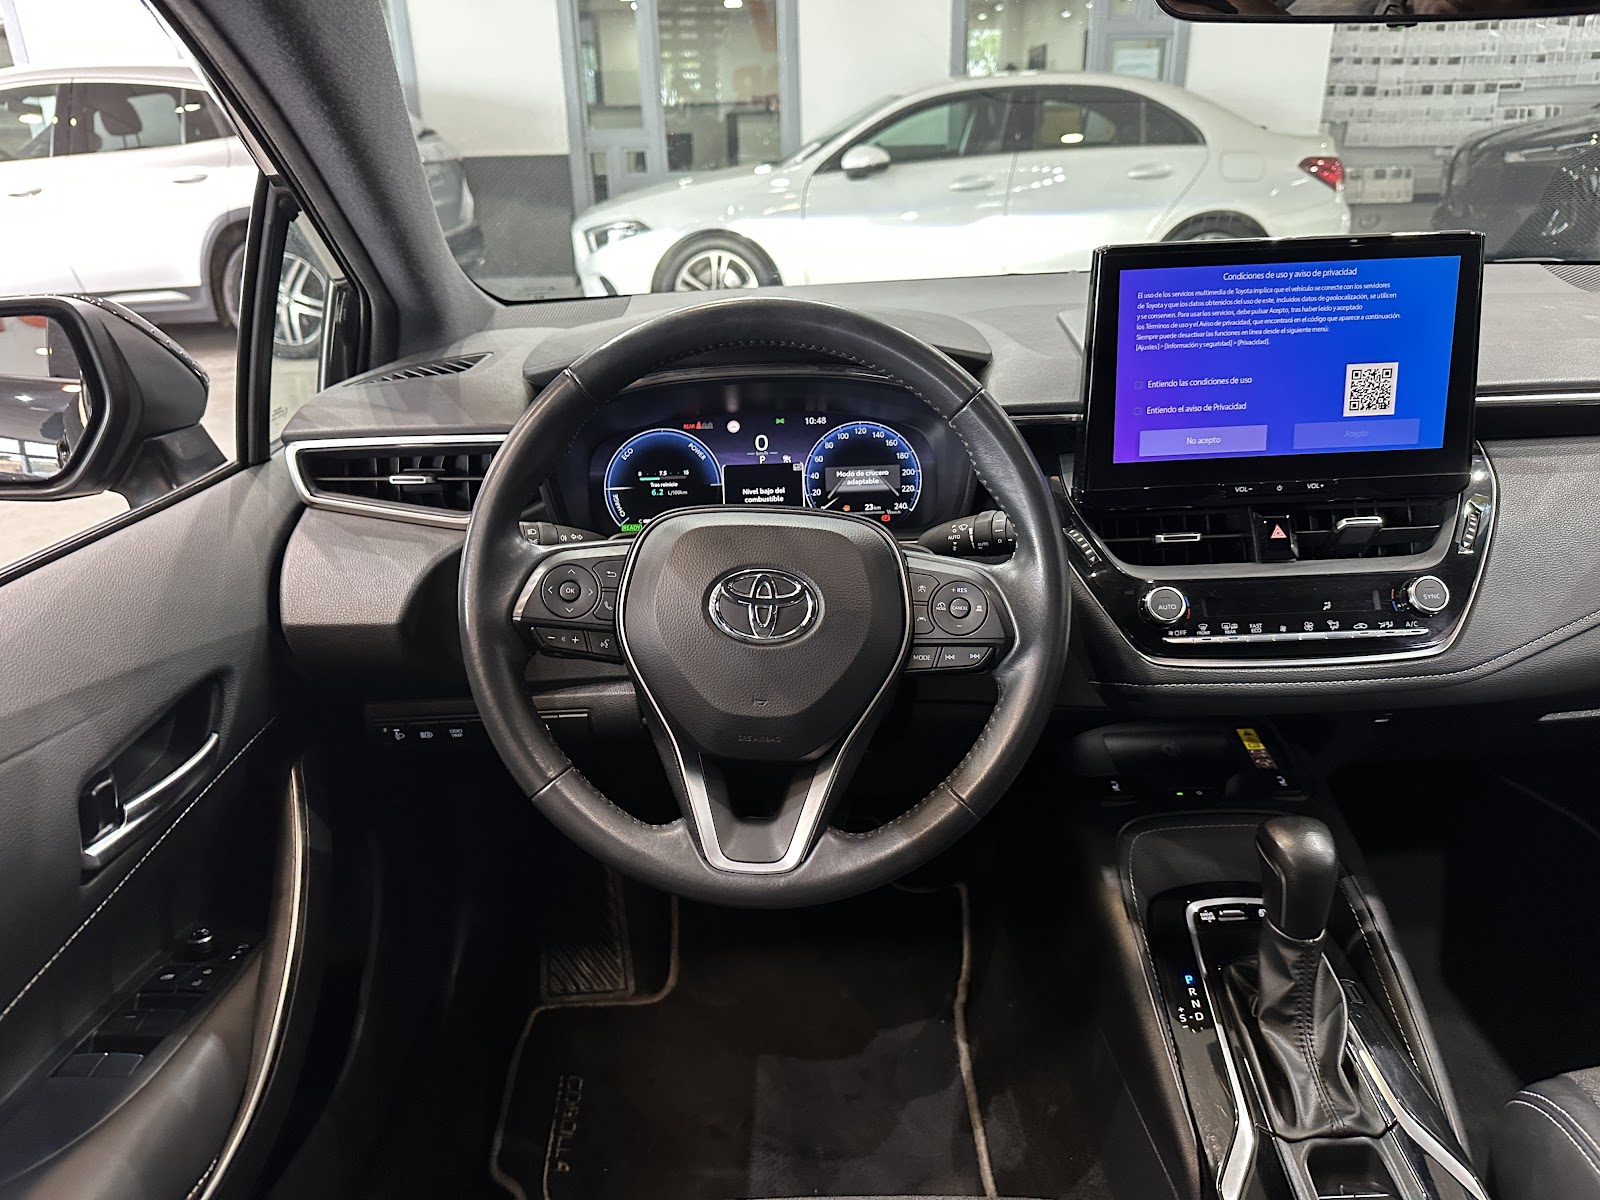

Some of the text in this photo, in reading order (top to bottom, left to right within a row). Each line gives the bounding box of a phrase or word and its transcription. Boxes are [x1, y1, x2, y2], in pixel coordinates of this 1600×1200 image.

[1224, 272, 1264, 281] Condiciones
[1266, 271, 1274, 279] de
[1288, 271, 1294, 280] y
[1294, 270, 1311, 278] aviso
[1322, 268, 1357, 278] privacidad
[1254, 286, 1273, 294] implica
[1326, 293, 1368, 302] geolocalización,
[1222, 319, 1252, 327] privacidad,
[1264, 316, 1293, 325] encontrará
[1164, 342, 1198, 351] [Información
[1203, 340, 1232, 348] seguridad]
[1147, 380, 1178, 388] Entiendo
[1179, 379, 1189, 387] las
[1190, 378, 1229, 386] condiciones
[1146, 406, 1176, 414] Entiendo
[1185, 404, 1202, 412] aviso
[1213, 402, 1247, 411] Privacidad
[1344, 430, 1368, 438] Acepto
[755, 434, 769, 451] 0
[1198, 437, 1221, 445] acepto
[621, 447, 634, 460] ECO
[688, 443, 707, 461] POWER
[760, 455, 766, 464] P
[613, 494, 625, 517] CHARGE
[1185, 975, 1193, 984] P
[1188, 988, 1197, 996] R
[1191, 999, 1201, 1008] N
[1179, 1012, 1204, 1022] S D
